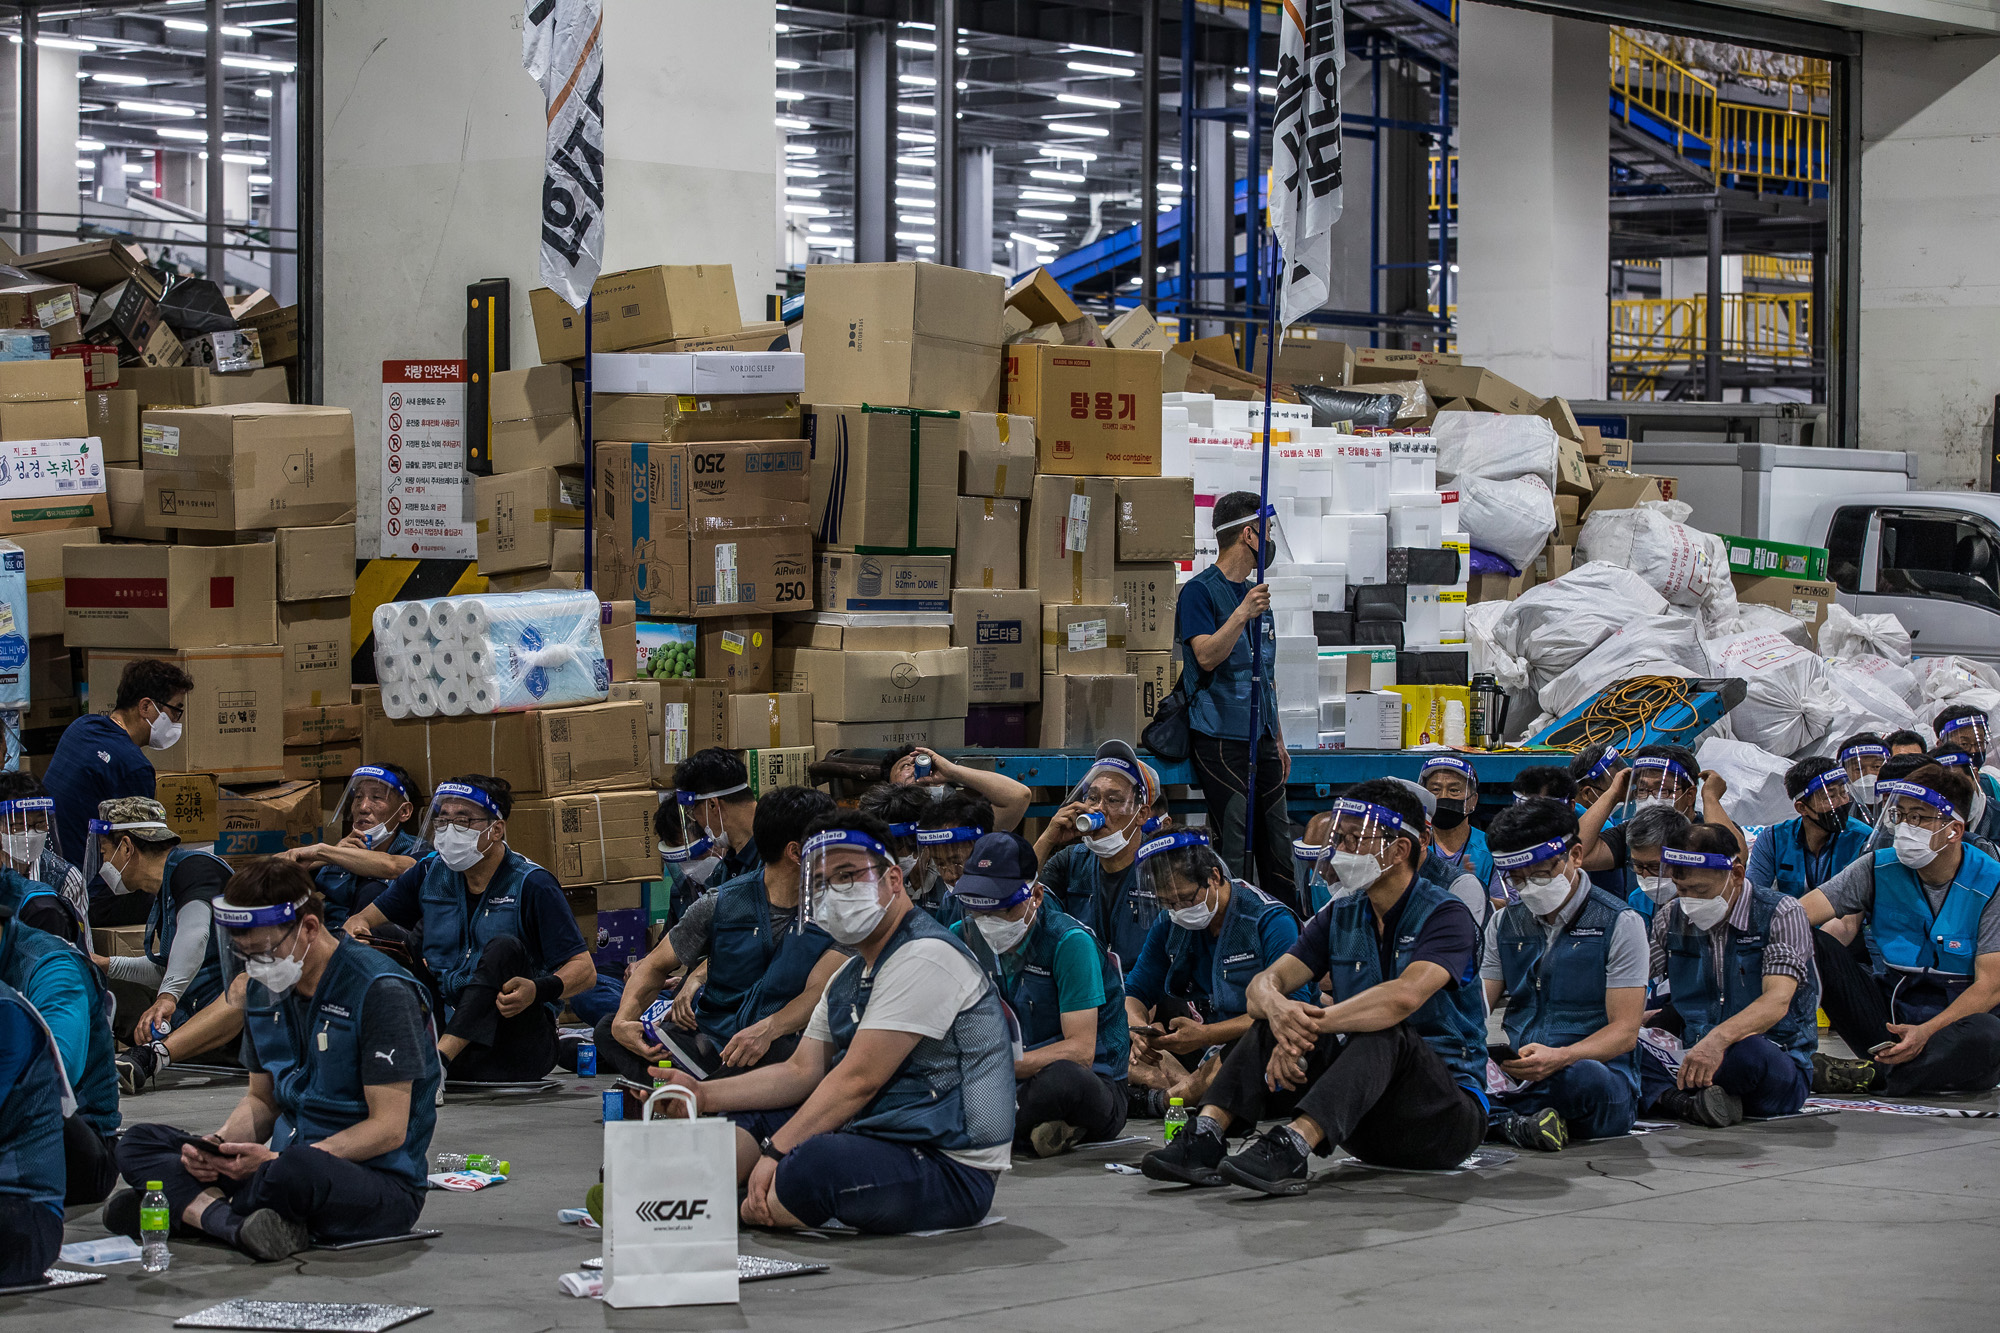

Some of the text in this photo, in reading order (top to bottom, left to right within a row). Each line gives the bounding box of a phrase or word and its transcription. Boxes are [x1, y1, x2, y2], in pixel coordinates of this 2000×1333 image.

[404, 364, 460, 378] 차량 안전수칙
[391, 396, 400, 406] 20
[416, 398, 436, 406] 운행속도
[437, 398, 446, 406] 준수
[1106, 453, 1152, 462] food container
[1348, 447, 1370, 458] 당일배송
[438, 462, 452, 470] 급회전
[454, 462, 463, 470] 금지
[694, 453, 726, 474] 250
[405, 477, 414, 485] 차량
[430, 477, 459, 485] 주차브레이크
[633, 462, 647, 503] 250
[774, 565, 806, 576] AIRwell
[896, 571, 912, 580] LIDS
[895, 580, 938, 588] 92mm DOME
[776, 581, 806, 602] 250
[10, 645, 26, 654] BATH
[1428, 699, 1437, 736] Maxim
[630, 719, 638, 767] DBBC-0329A
[448, 784, 470, 792] Shield
[1903, 784, 1924, 794] Shield
[174, 793, 202, 806] 초가을
[174, 808, 204, 822] 우엉차
[226, 820, 260, 830] AIRwell
[642, 811, 651, 858] DBBC-0329A
[816, 832, 842, 841] Shield
[226, 834, 259, 852] 250
[1150, 838, 1172, 850] Shield
[1506, 854, 1531, 864] Shield
[1678, 854, 1702, 863] Shield
[224, 912, 248, 921] Shield
